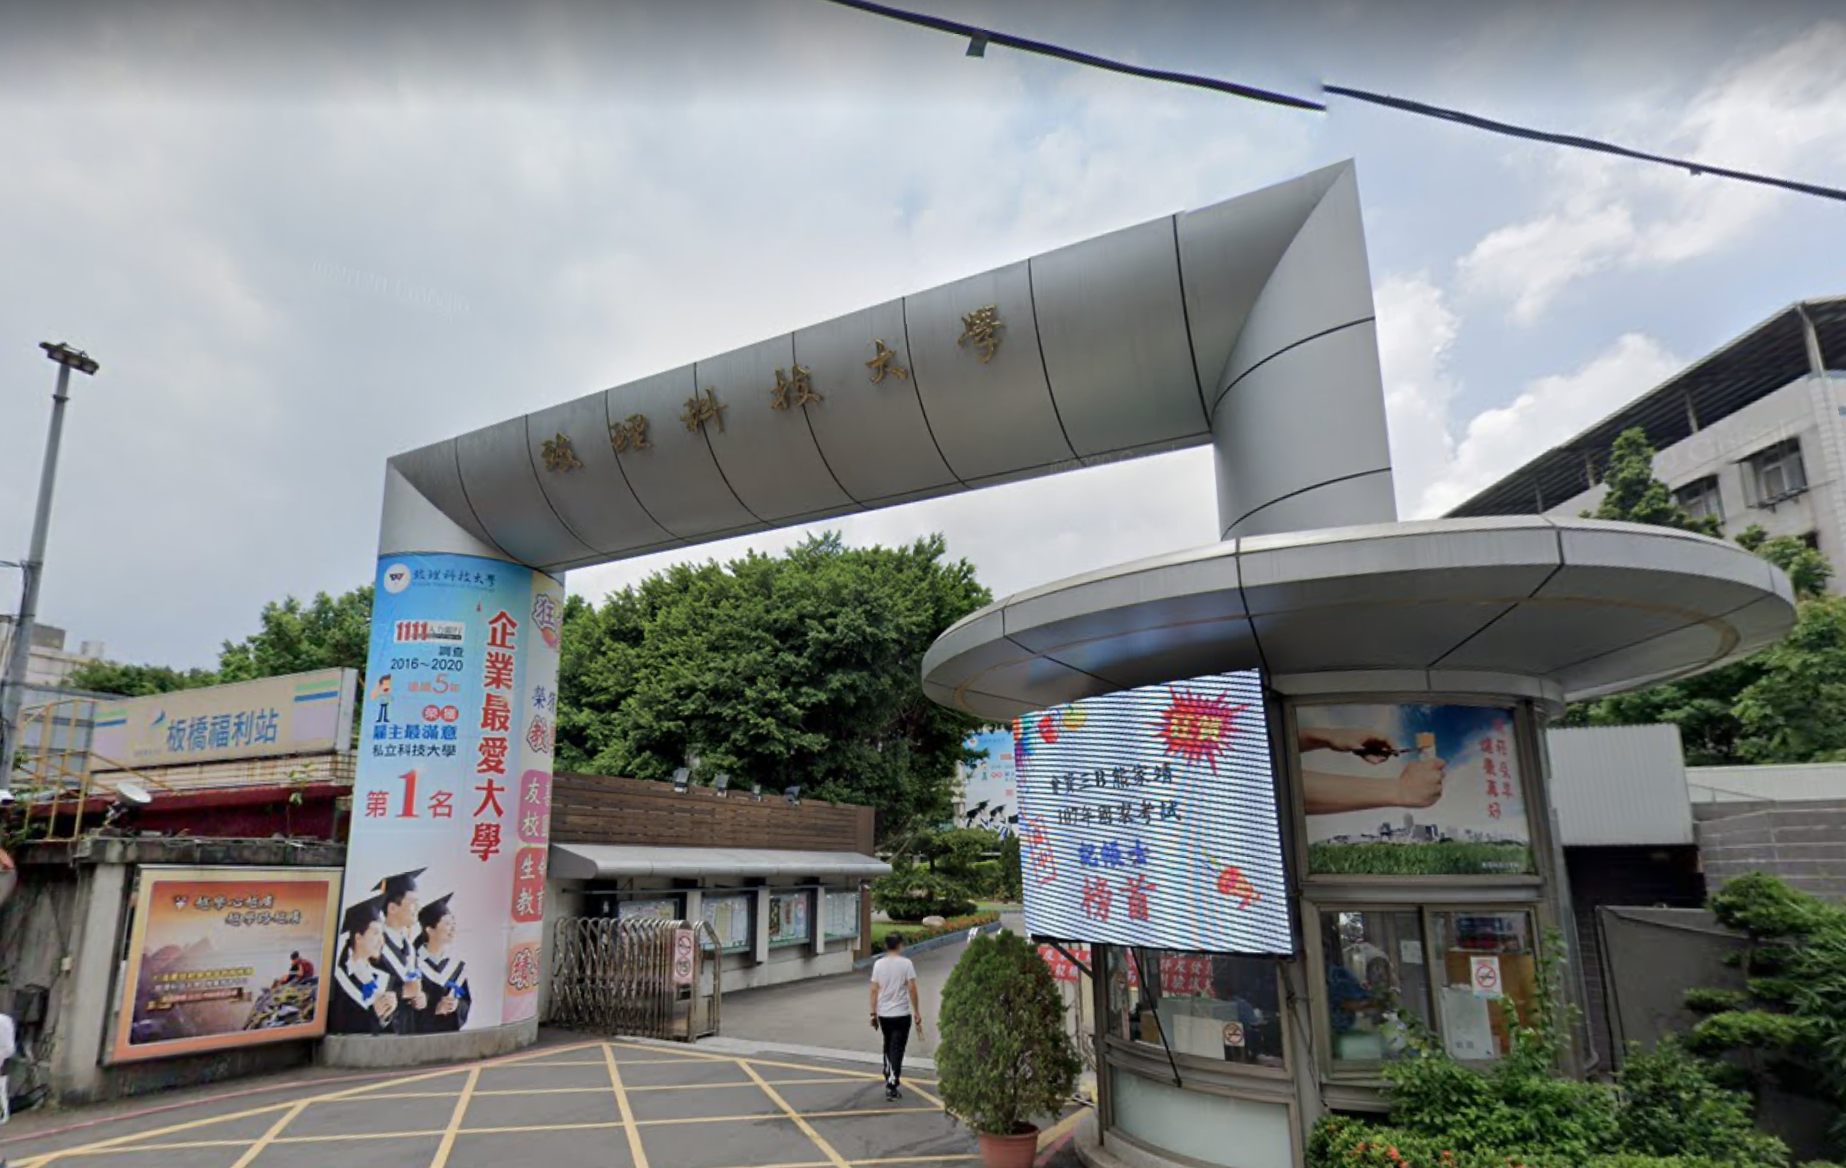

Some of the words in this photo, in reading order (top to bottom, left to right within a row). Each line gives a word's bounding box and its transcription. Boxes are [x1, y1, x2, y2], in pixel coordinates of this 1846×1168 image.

[167, 708, 280, 752] 板橋福利站
[372, 743, 457, 757] 私立科技大學
[373, 724, 458, 741] 雇主最滿意
[470, 610, 518, 862] 企業最愛大學
[364, 769, 454, 818] 第1名
